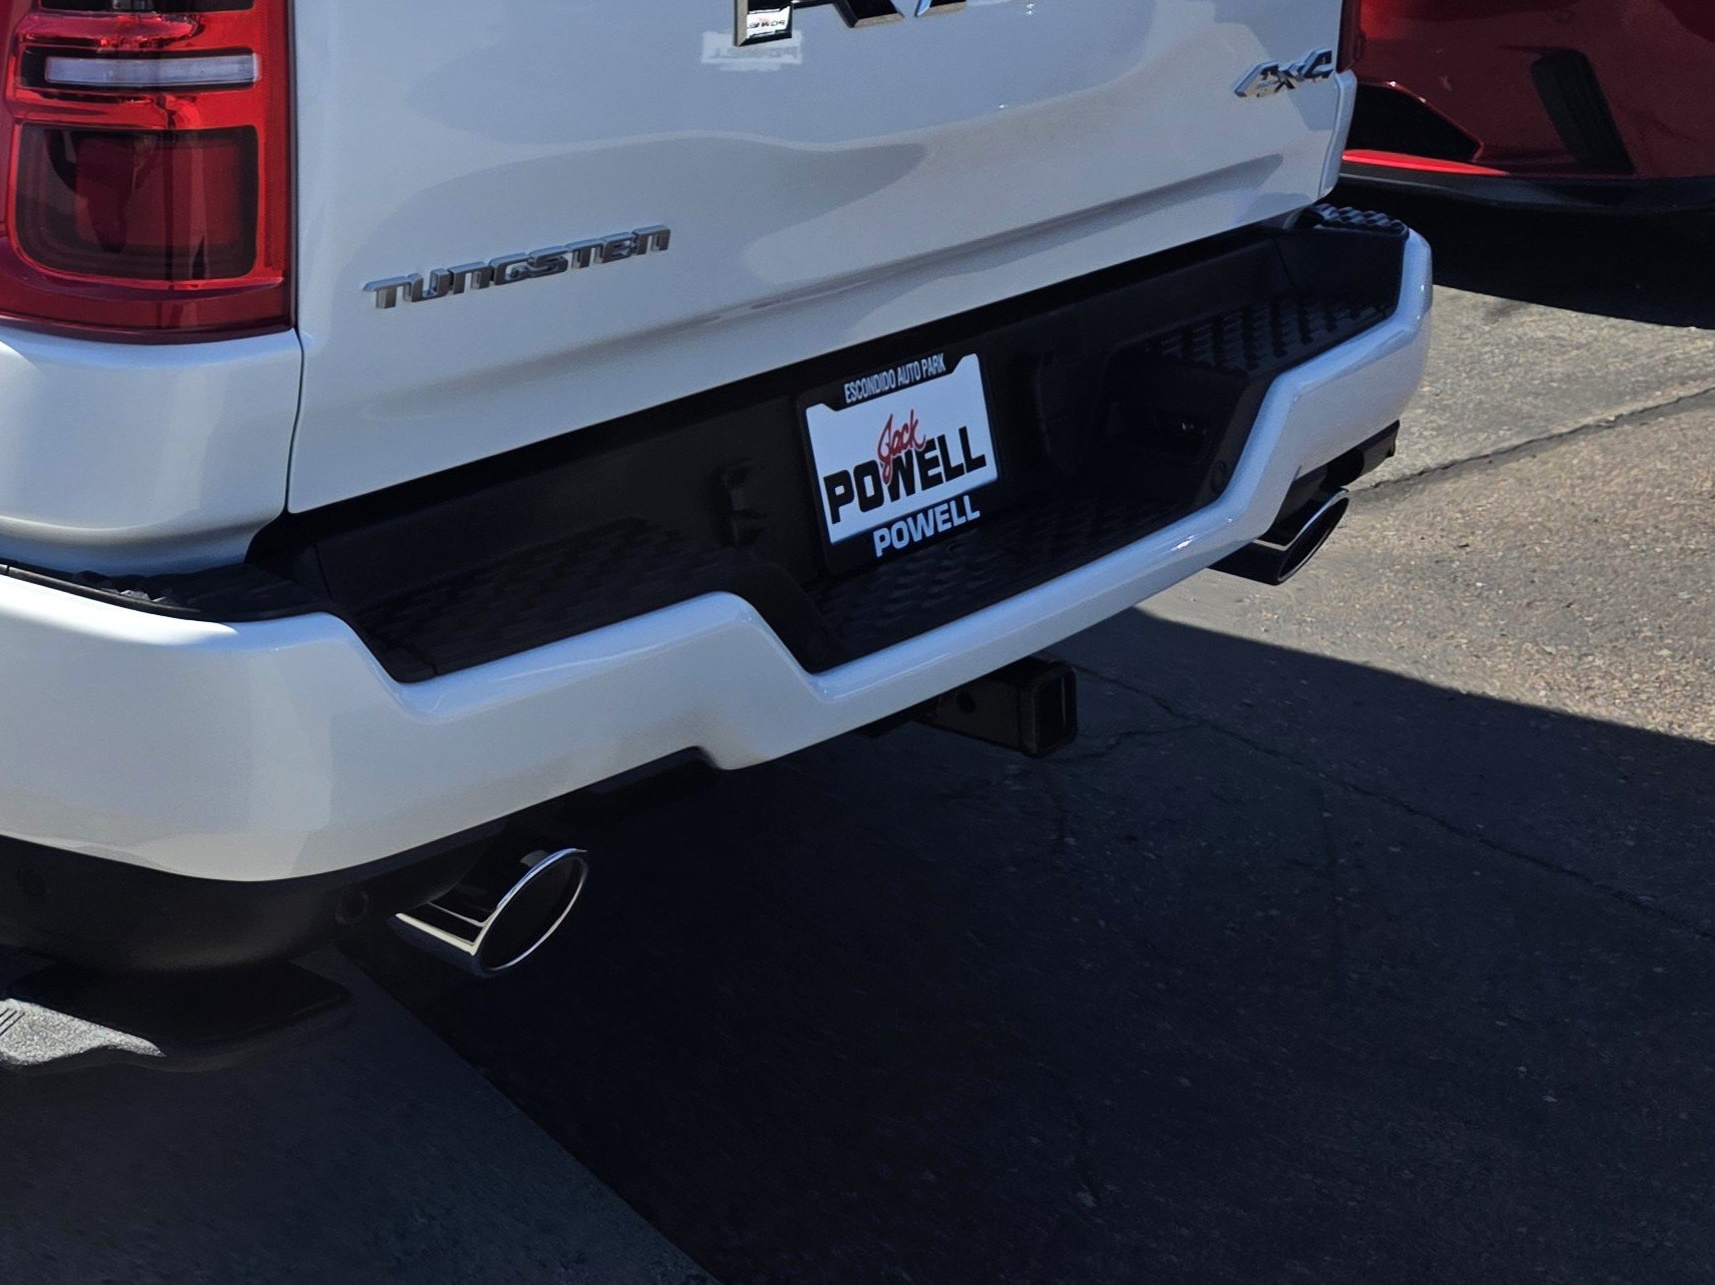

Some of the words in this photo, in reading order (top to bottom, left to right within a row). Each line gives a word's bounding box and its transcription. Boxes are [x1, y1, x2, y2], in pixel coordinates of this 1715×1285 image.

[362, 224, 672, 309] TUNGSTEN
[844, 369, 897, 404] ESCONDIDO
[897, 361, 921, 387] AUTO
[921, 352, 947, 380] PARK
[823, 425, 988, 525] POWELL
[877, 408, 927, 485] Jack
[873, 494, 981, 558] POWELL
